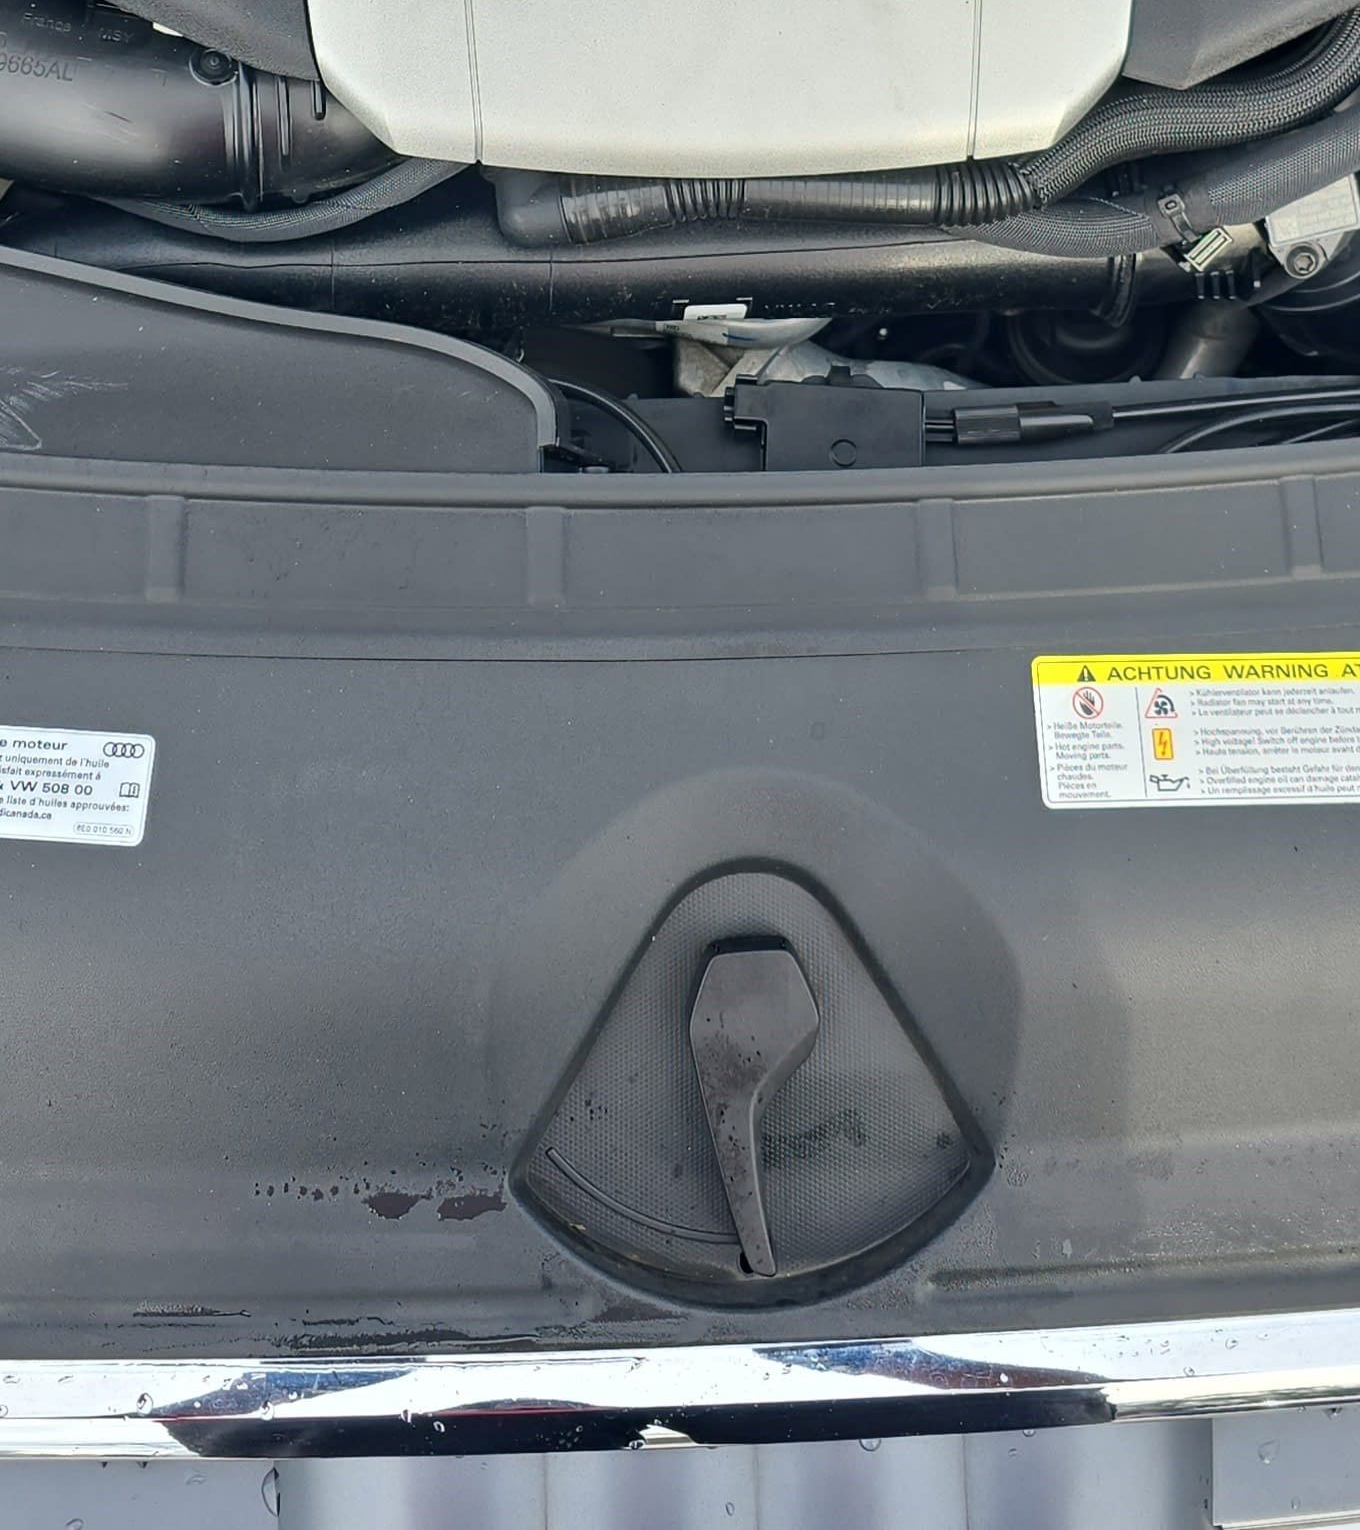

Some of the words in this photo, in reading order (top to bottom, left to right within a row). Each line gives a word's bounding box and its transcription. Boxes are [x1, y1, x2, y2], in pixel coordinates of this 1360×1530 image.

[1105, 665, 1211, 681] ACHTUNG
[1222, 663, 1329, 679] WARNING
[1197, 698, 1230, 706] Radiator
[1247, 698, 1265, 706] may
[1266, 697, 1285, 705] start
[1254, 707, 1272, 716] peut
[1337, 706, 1354, 714] tout
[13, 740, 68, 751] moteur
[1071, 741, 1099, 751] engine
[1201, 737, 1220, 746] High
[1257, 736, 1283, 745] Switch
[1299, 736, 1326, 744] engine
[1328, 735, 1354, 744] before
[1055, 751, 1087, 760] Moving
[1300, 746, 1329, 755] moteur
[1331, 746, 1354, 754] avant
[5, 754, 63, 766] uniquement
[66, 756, 77, 766] de
[1097, 762, 1128, 770] moteur
[1270, 764, 1301, 774] besteht
[25, 769, 93, 780] expressément
[1206, 775, 1246, 785] Overfilled
[1247, 775, 1275, 784] engine
[1305, 774, 1338, 783] damage
[10, 780, 37, 792] VW
[42, 782, 69, 794] 508
[74, 785, 93, 796] 00
[1221, 786, 1271, 795] remplissage
[1336, 784, 1354, 793] peut
[6, 796, 26, 806] liste
[70, 800, 130, 812] approuvées:
